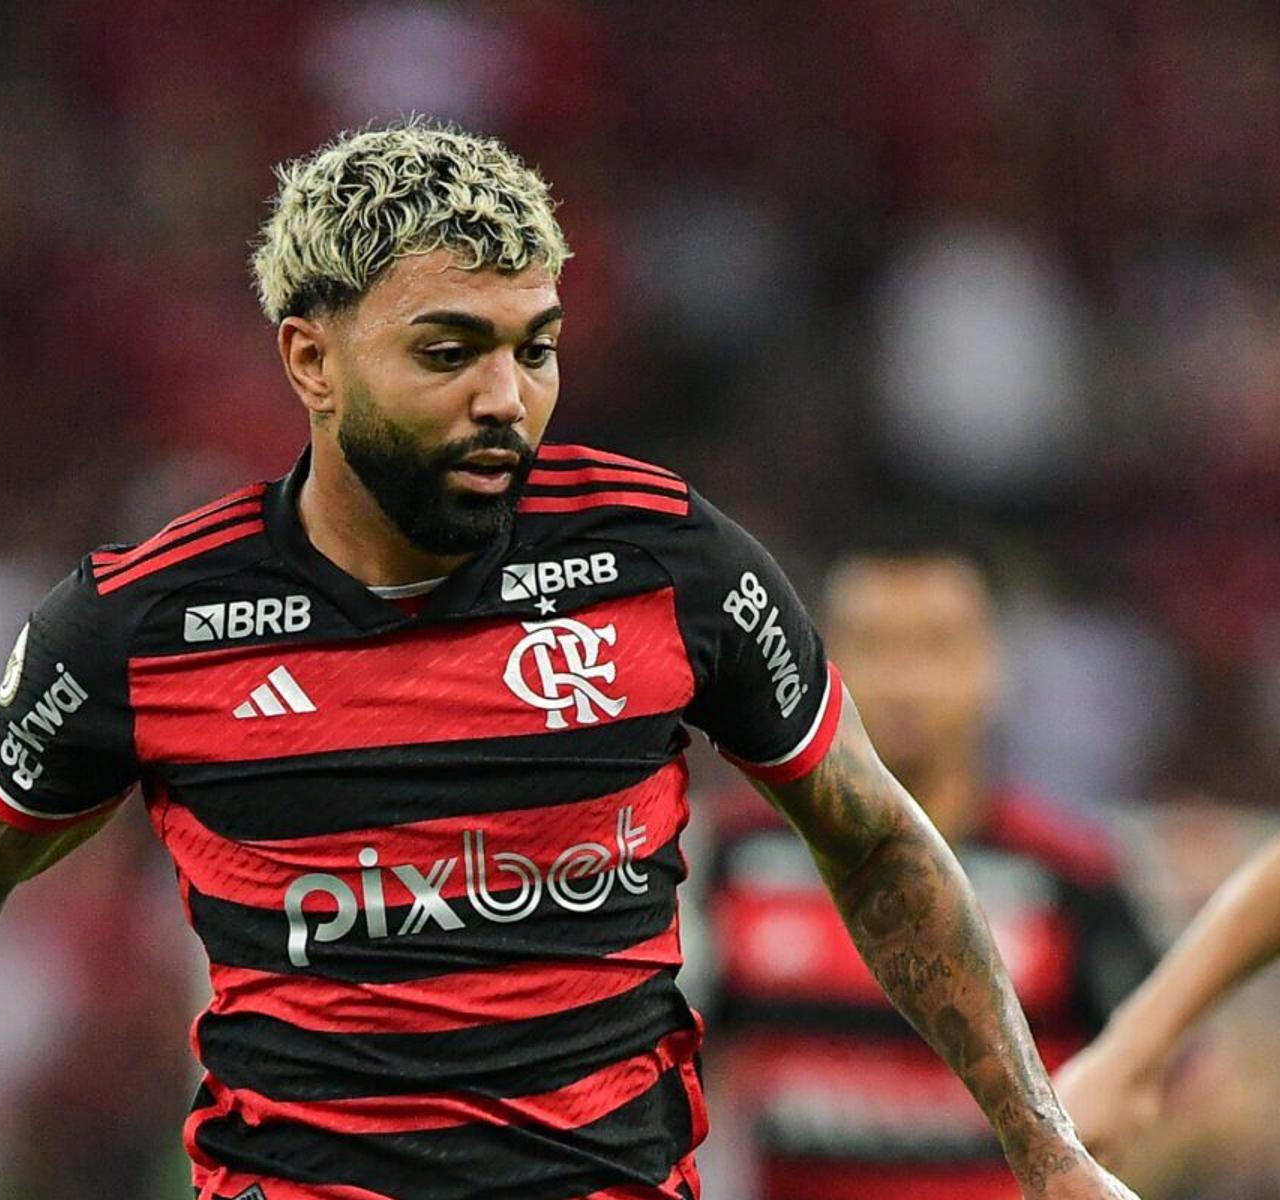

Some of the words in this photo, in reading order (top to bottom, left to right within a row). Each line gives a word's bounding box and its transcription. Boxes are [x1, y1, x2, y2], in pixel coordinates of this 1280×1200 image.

[227, 595, 311, 639] BRB
[538, 552, 619, 594] BRB
[7, 662, 89, 753] kwai
[755, 605, 809, 719] kwai
[283, 804, 649, 968] pixbet
